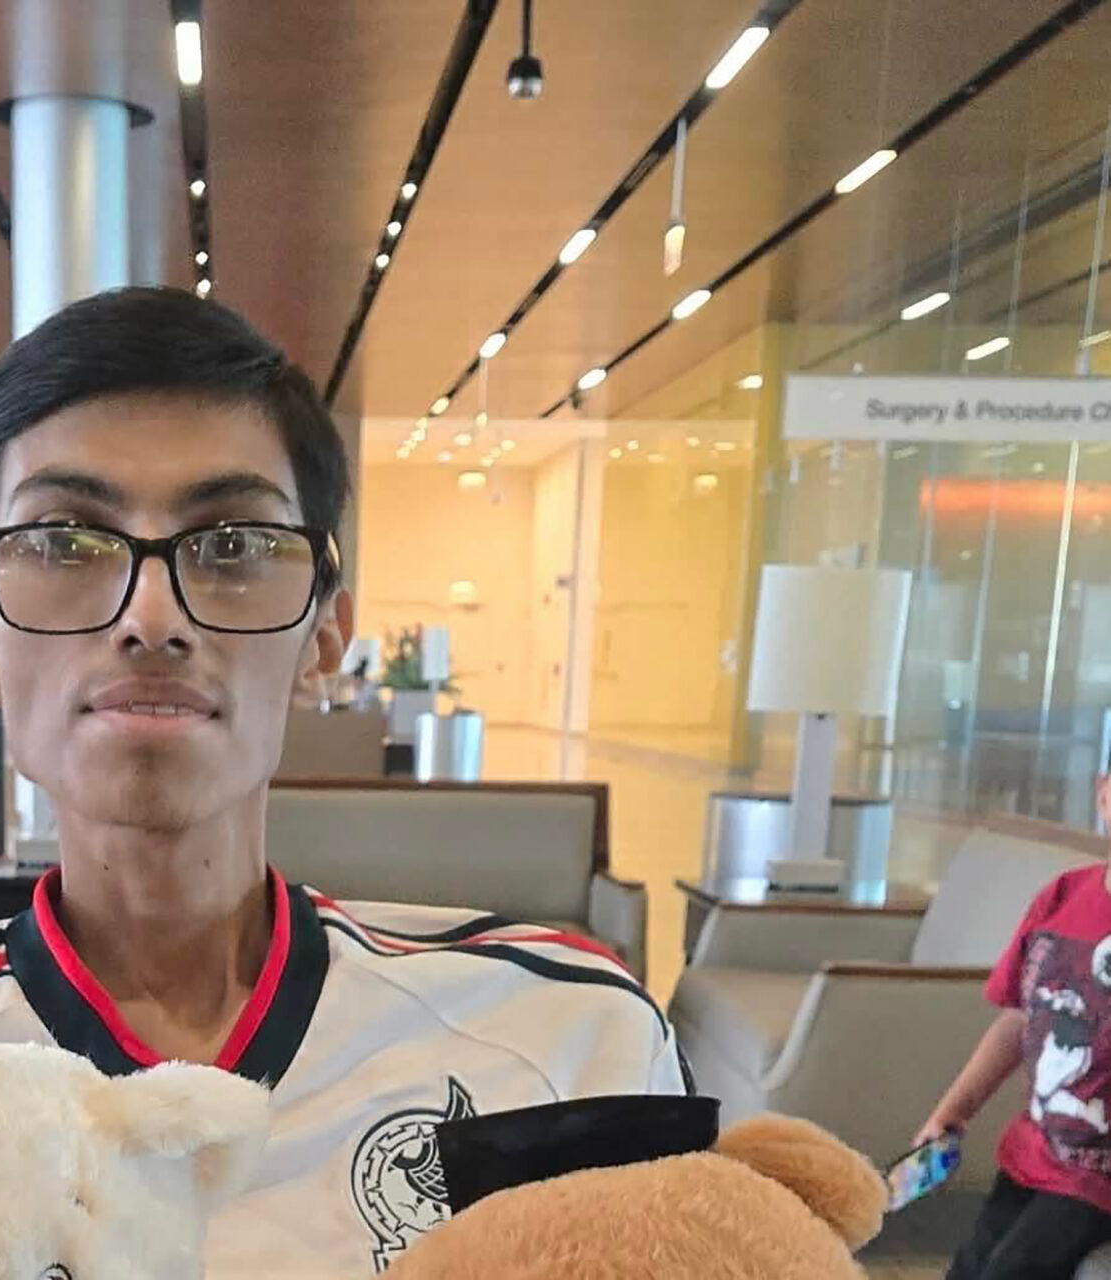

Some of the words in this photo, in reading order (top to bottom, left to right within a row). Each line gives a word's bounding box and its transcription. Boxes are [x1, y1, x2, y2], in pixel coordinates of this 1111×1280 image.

[866, 397, 949, 426] Surgery
[955, 399, 969, 421] &
[975, 399, 1083, 422] Procedure
